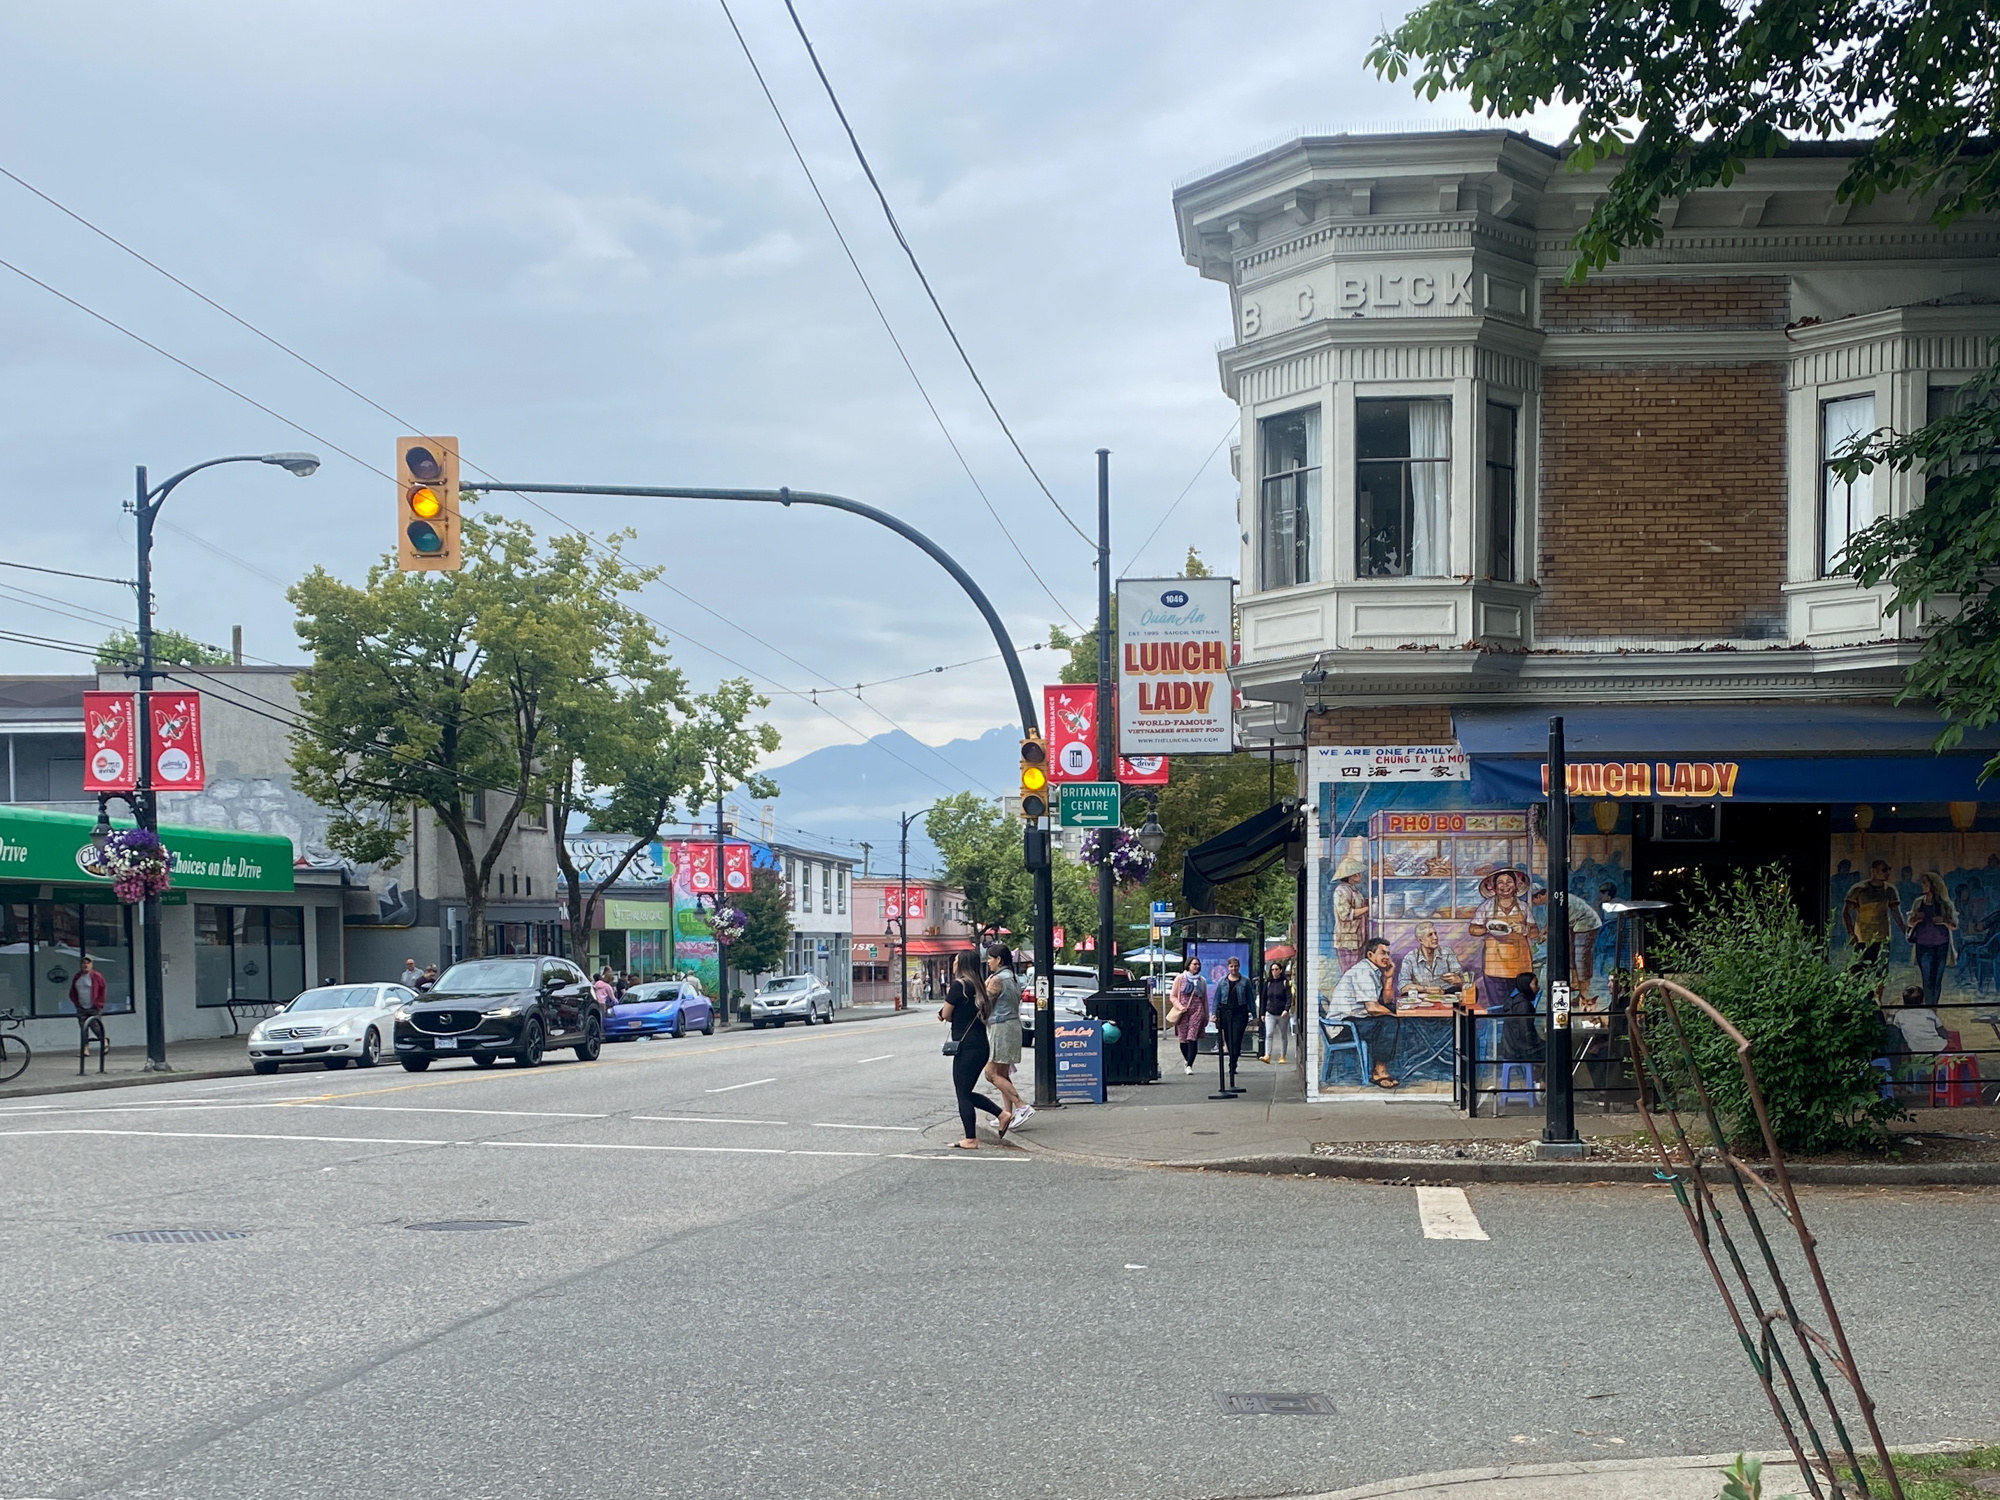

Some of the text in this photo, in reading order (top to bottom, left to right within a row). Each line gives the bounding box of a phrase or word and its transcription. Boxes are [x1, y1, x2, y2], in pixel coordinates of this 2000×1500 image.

[1243, 284, 1315, 337] B C
[1165, 595, 1184, 603] 1046
[1140, 609, 1177, 626] Quán
[1125, 641, 1227, 675] LUNCH
[1138, 681, 1215, 715] LADY
[1407, 747, 1454, 755] FAMILY
[1415, 755, 1427, 763] TA
[1341, 765, 1454, 778] 四海一家
[1656, 762, 1739, 796] LADY
[1062, 787, 1117, 797] BRITANNIA
[1071, 801, 1108, 810] CENTRE
[171, 851, 262, 879] Choices on the Drive
[1060, 1041, 1087, 1049] OPEN
